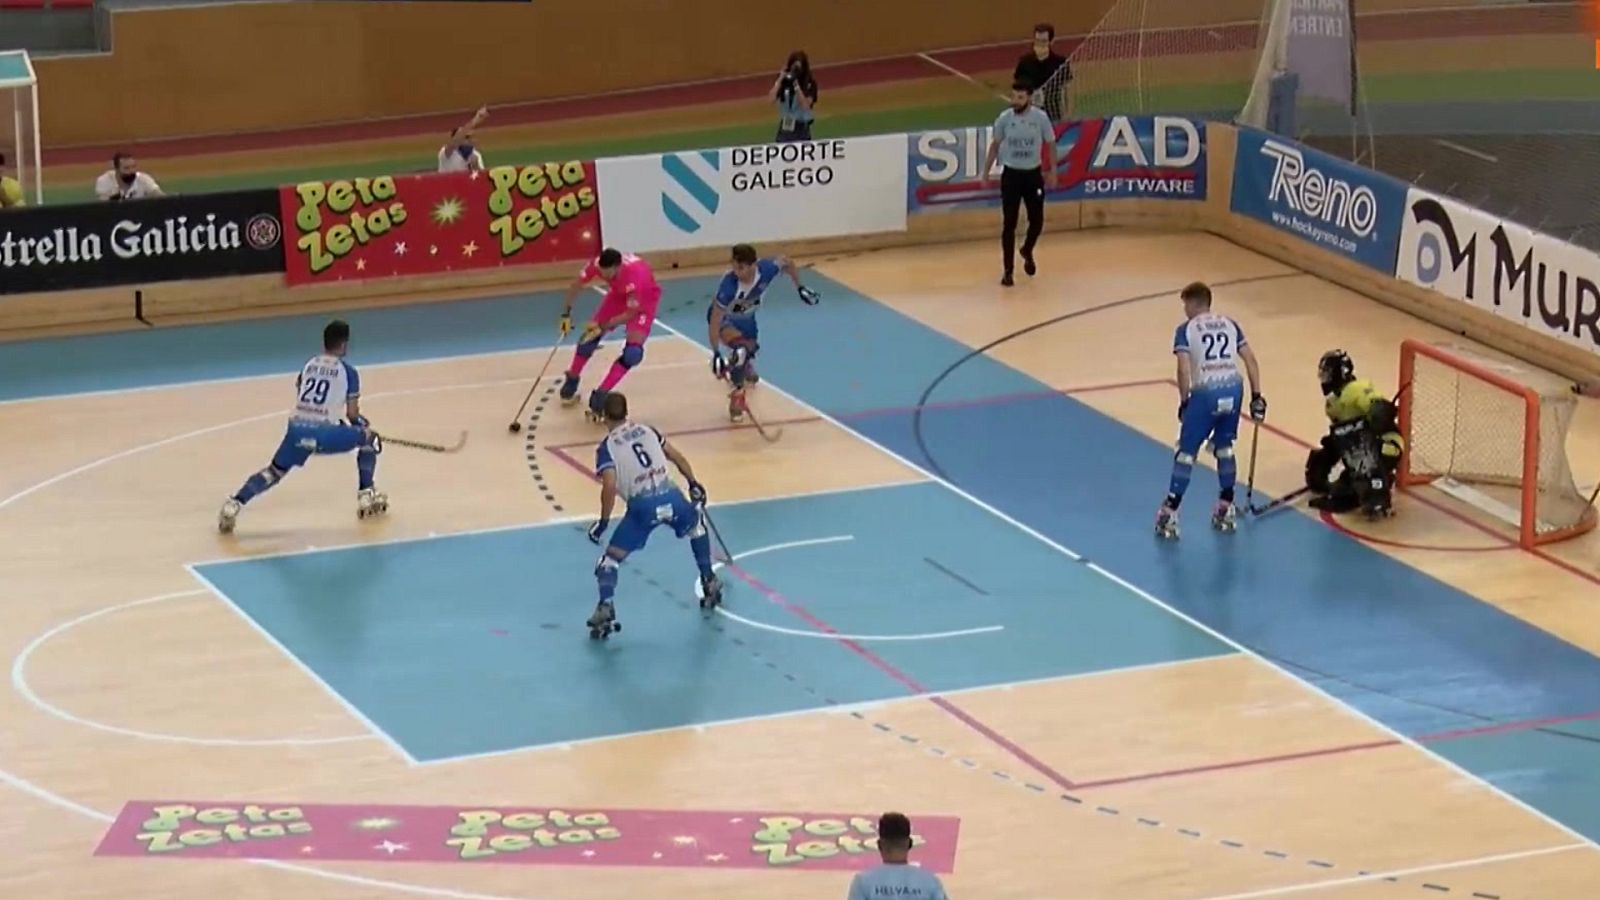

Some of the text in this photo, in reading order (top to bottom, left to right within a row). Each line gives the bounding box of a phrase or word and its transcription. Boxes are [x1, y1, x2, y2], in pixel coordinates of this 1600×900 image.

[732, 140, 846, 167] DEPORTE
[488, 160, 586, 215] Peta
[731, 166, 834, 191] GALEGO
[1084, 177, 1194, 193] SOFTWARE
[1260, 139, 1377, 237] Reno
[296, 175, 397, 232] Peta
[490, 186, 595, 255] Zetas
[0, 213, 241, 267] trella Galicia
[298, 202, 407, 273] Zetas
[1202, 332, 1231, 360] 22
[301, 377, 330, 405] 29
[632, 442, 652, 468] 6
[143, 804, 303, 832] Peta
[451, 810, 610, 836] Peta
[754, 816, 877, 842] Pet
[136, 822, 313, 852] Zetas
[446, 827, 621, 859] Zetas
